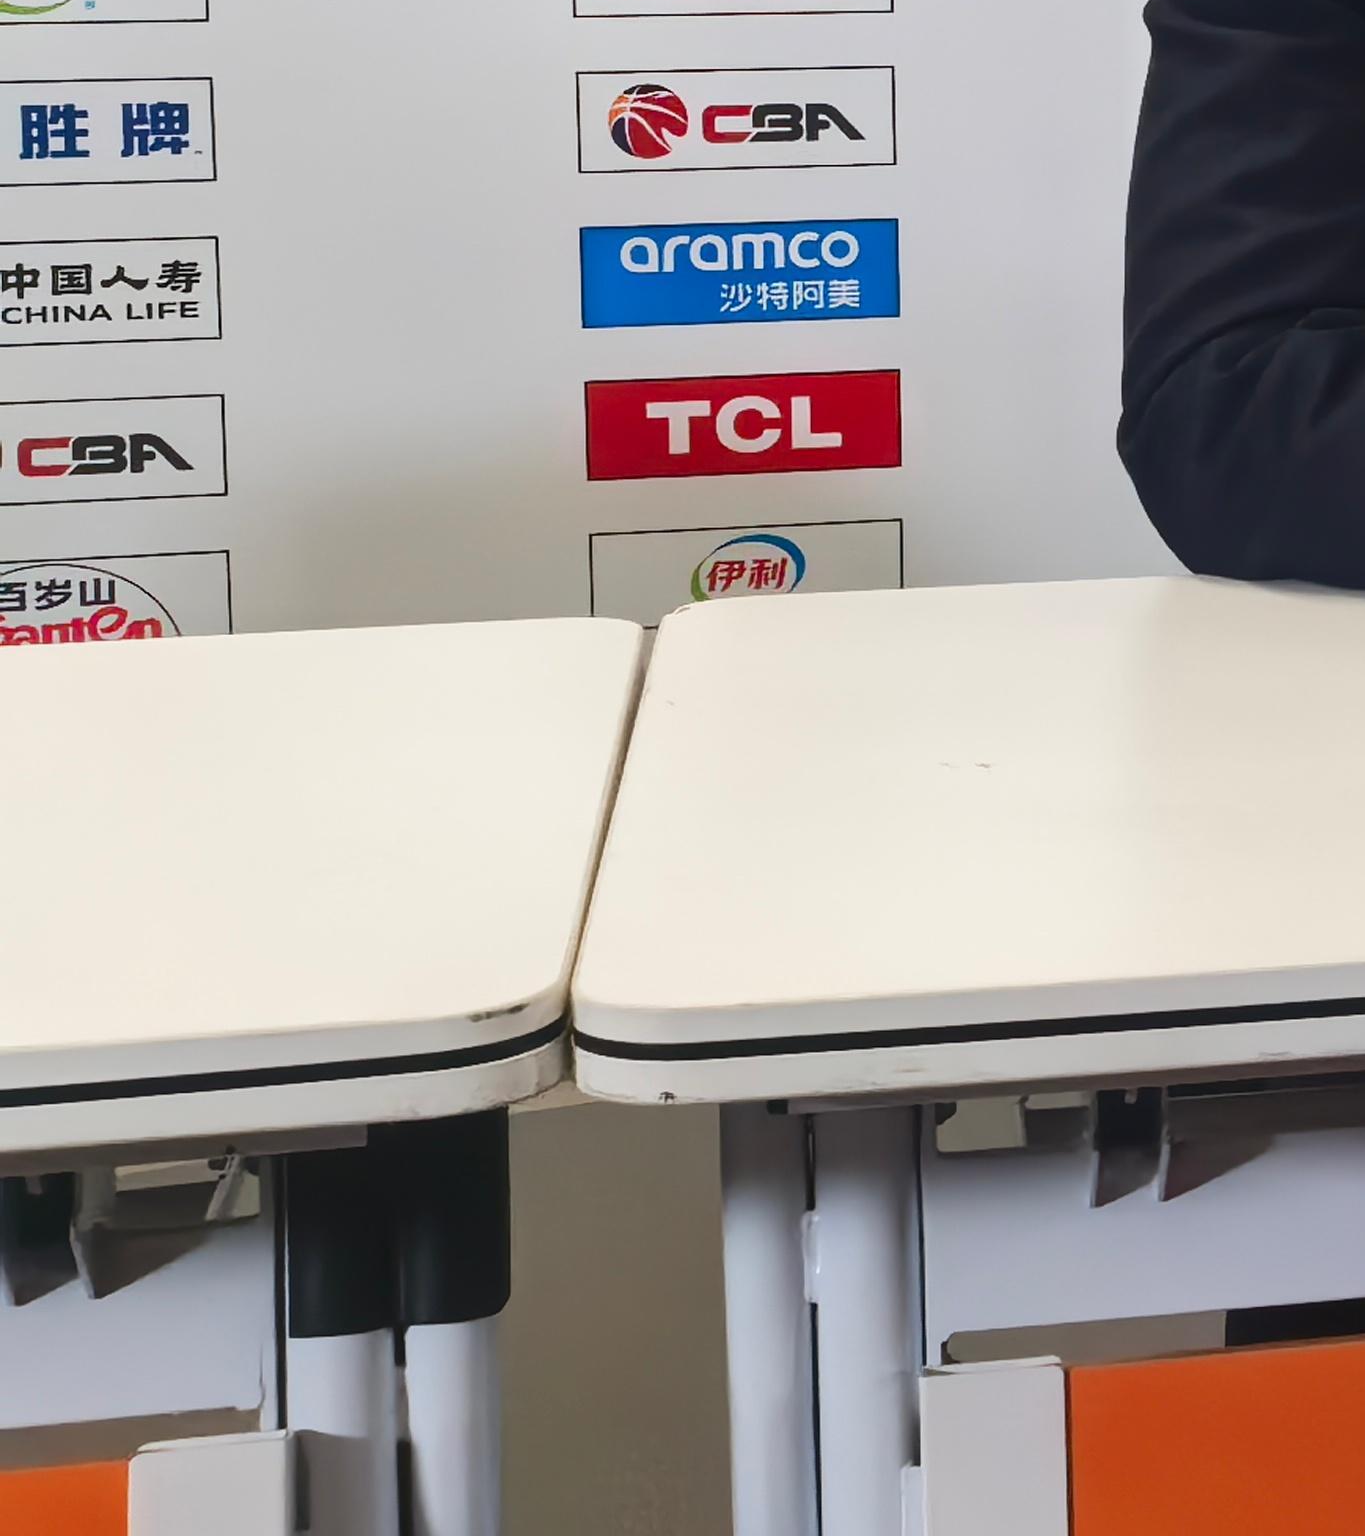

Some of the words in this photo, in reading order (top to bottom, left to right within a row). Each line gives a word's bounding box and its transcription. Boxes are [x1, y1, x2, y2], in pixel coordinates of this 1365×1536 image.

[19, 102, 189, 160] 胜牌
[702, 103, 865, 143] CBA
[620, 231, 859, 272] aramco
[0, 260, 201, 299] 中国人寿
[720, 279, 860, 312] 沙特阿美
[2, 305, 112, 324] CHINA
[127, 301, 199, 320] LIFE
[646, 396, 842, 454] TCL
[17, 433, 194, 477] CBA
[706, 558, 787, 592] 伊利
[0, 578, 115, 612] 百岁山
